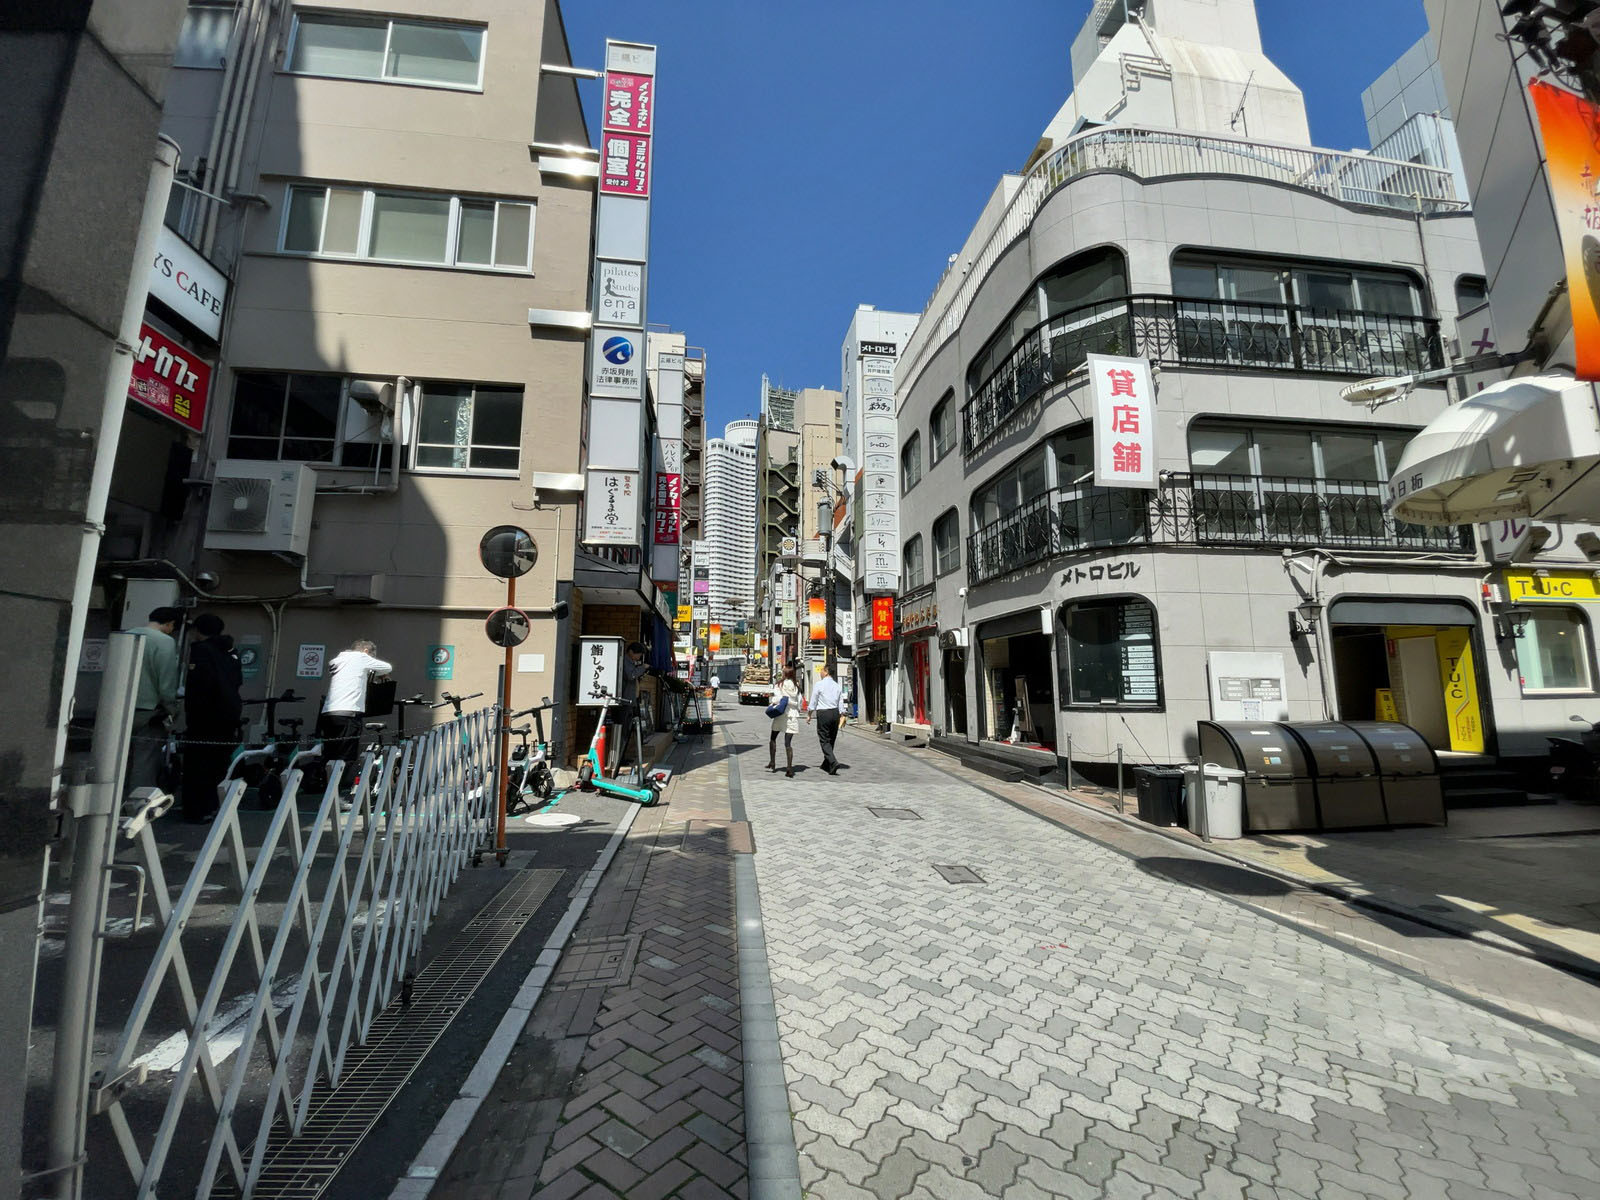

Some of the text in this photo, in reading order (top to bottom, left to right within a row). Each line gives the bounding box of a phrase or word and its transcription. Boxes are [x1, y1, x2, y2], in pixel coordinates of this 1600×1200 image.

[608, 90, 631, 126] 完全
[637, 81, 649, 128] インターネット
[606, 138, 630, 176] 個室
[634, 140, 647, 191] コミックカフェ
[603, 267, 639, 278] pilates
[176, 271, 222, 317] CAFE
[611, 282, 640, 292] studio
[604, 298, 636, 310] ena
[611, 311, 626, 320] 4F
[861, 344, 896, 354] メトロビル
[134, 336, 199, 393] トカフェ
[601, 368, 634, 377] 赤坂見附
[596, 376, 638, 386] 法律事務所
[1106, 368, 1142, 473] 貸店舗
[604, 476, 619, 526] はぐるま堂
[656, 511, 667, 534] カフェ
[1061, 561, 1141, 587] メトロビル
